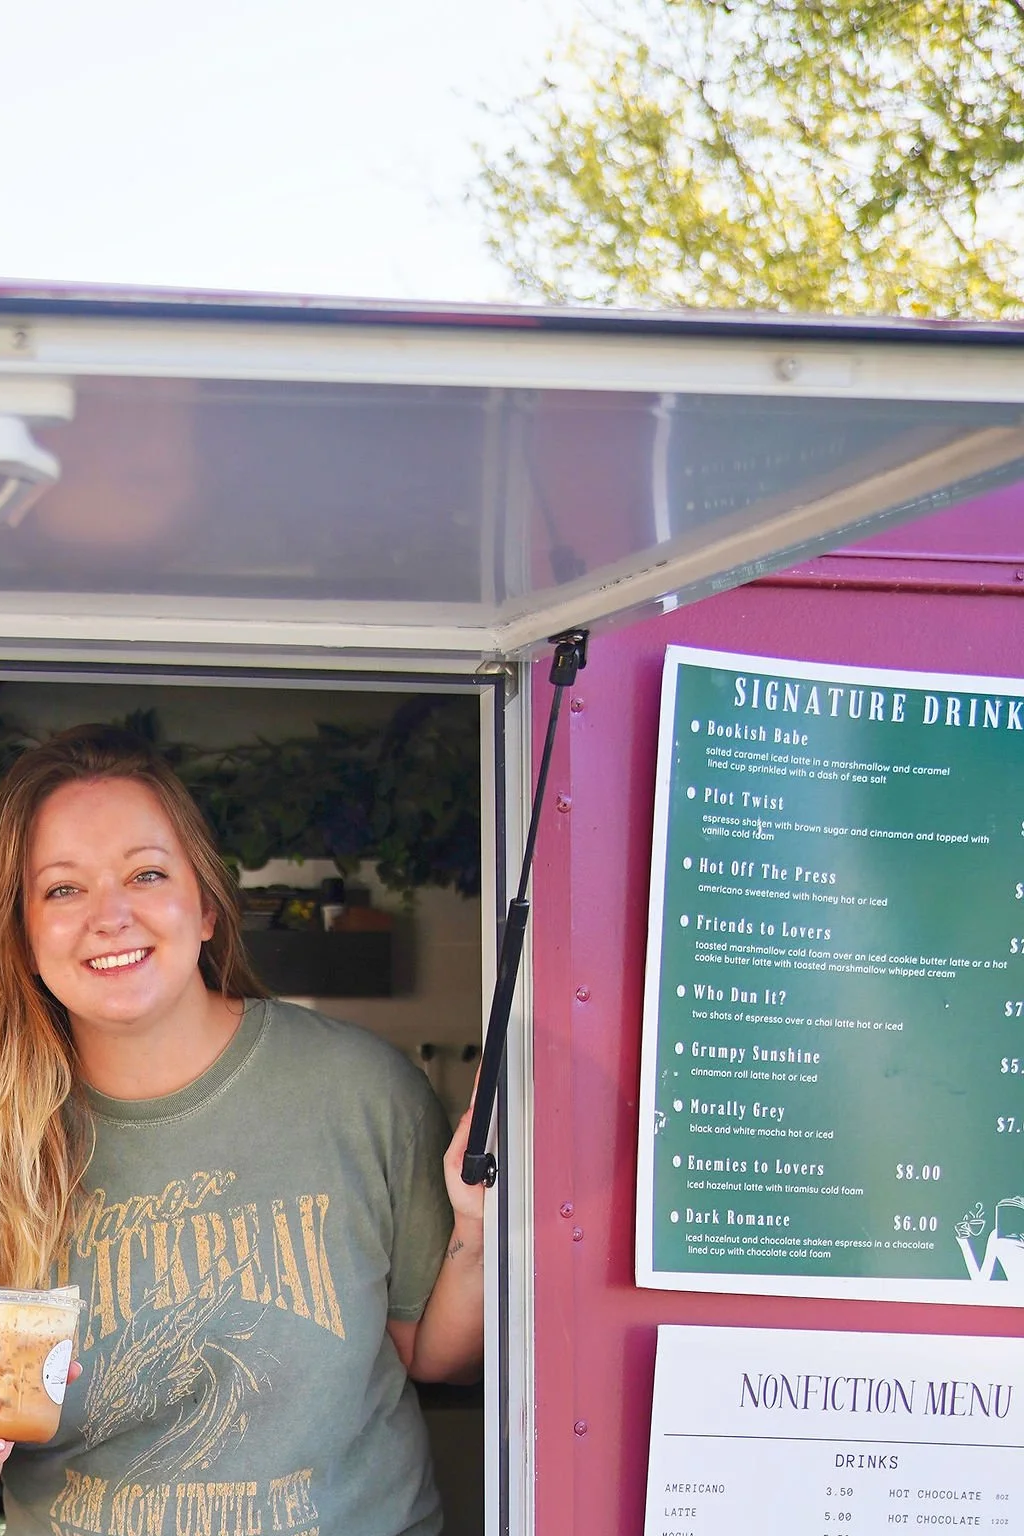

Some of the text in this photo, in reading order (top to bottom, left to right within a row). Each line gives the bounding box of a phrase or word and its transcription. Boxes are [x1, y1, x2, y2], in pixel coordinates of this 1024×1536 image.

[734, 677, 1024, 730] SIGNATURE DRINK
[707, 720, 808, 746] Bookish Babe
[706, 747, 732, 757] salted
[734, 750, 769, 761] caramel
[770, 754, 789, 763] iced
[790, 755, 811, 766] latte
[812, 758, 821, 766] in
[831, 761, 891, 772] marshmallow
[892, 764, 911, 774] and
[912, 767, 950, 776] caramel
[704, 787, 784, 810] Plot Twist
[702, 827, 774, 840] vanilla cold foam
[699, 857, 836, 884] Hot Off The Press
[698, 884, 744, 896] americano
[744, 888, 791, 900] sweetened
[792, 892, 810, 900] with
[812, 892, 838, 904] honey
[840, 895, 855, 904] hot
[869, 898, 888, 906] iced
[696, 914, 831, 940] Friends to Lovers
[693, 984, 786, 1005] Who Dun It?
[692, 1041, 820, 1064] Grumpy Sunshine
[690, 1067, 818, 1082] cinnamon roll latte hot or iced
[690, 1098, 785, 1122] Morally Grey
[690, 1123, 713, 1133] black
[714, 1125, 731, 1134] and
[732, 1126, 757, 1136] white
[757, 1128, 787, 1139] mocha
[788, 1128, 802, 1138] hot
[816, 1130, 834, 1139] iced
[688, 1155, 940, 1180] Enemies to Lovers $8.00
[687, 1180, 864, 1195] iced hazelnut latte with tiramisu cold foam
[686, 1208, 937, 1232] Dark Romance $6.00
[739, 1373, 1013, 1419] NONFICTION MENU
[835, 1454, 898, 1470] DRINKS
[49, 1468, 110, 1534] FROM
[664, 1483, 854, 1497] AMERICANO 3.50
[889, 1488, 982, 1500] HOT CHOCOLATE
[664, 1507, 852, 1522] LATTE 5.00
[888, 1514, 980, 1526] HOT CHOCOLATE
